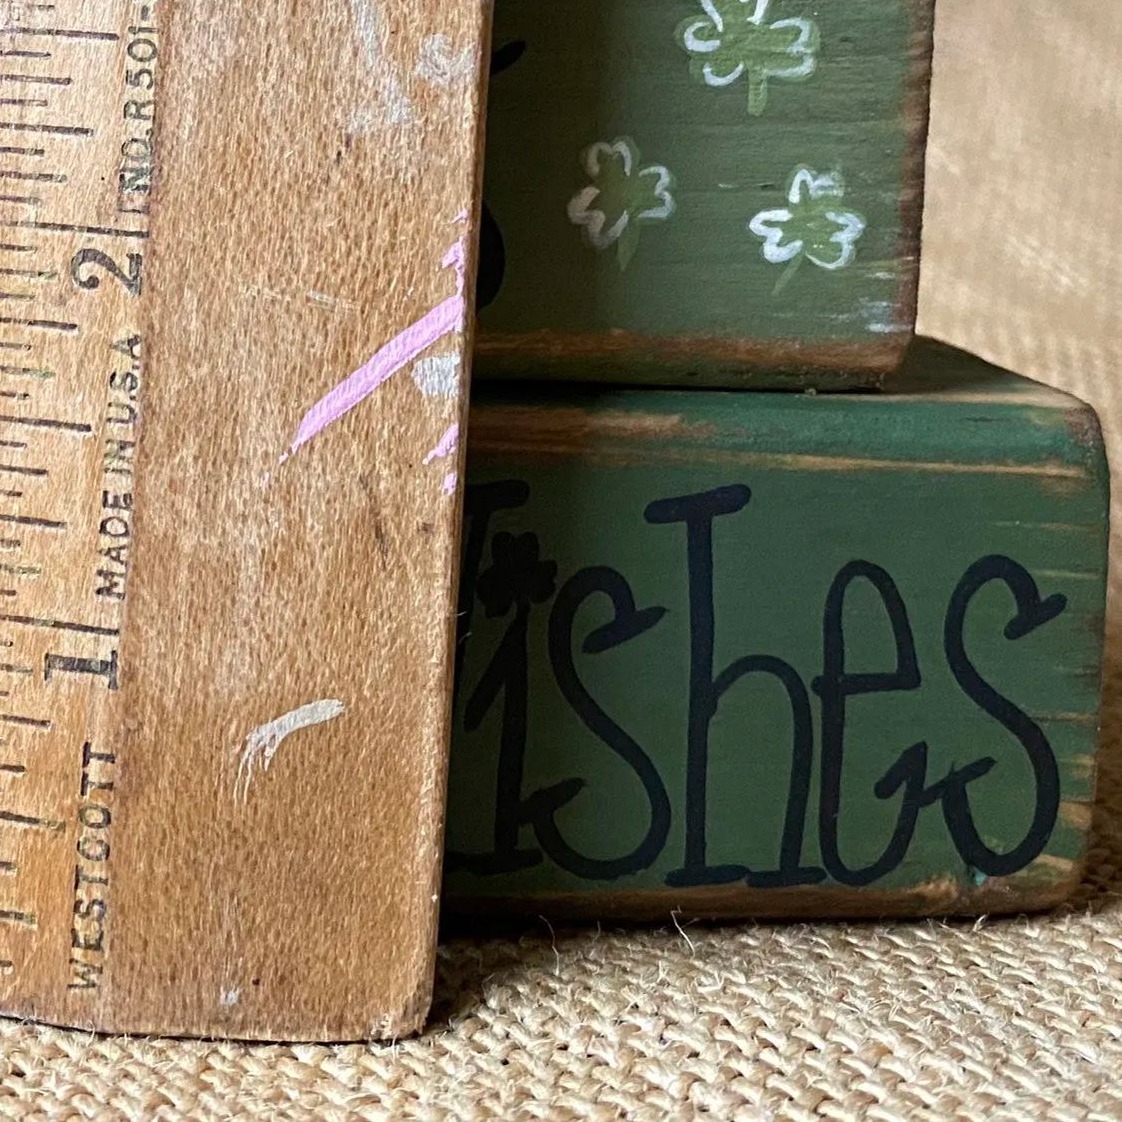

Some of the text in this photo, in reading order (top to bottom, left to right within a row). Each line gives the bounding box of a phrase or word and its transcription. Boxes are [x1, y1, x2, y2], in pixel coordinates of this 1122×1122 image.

[71, 247, 143, 298] 2
[104, 440, 135, 475] IN
[95, 490, 132, 601] MADE
[44, 650, 118, 690] 1
[68, 741, 116, 991] WESTCOTT
